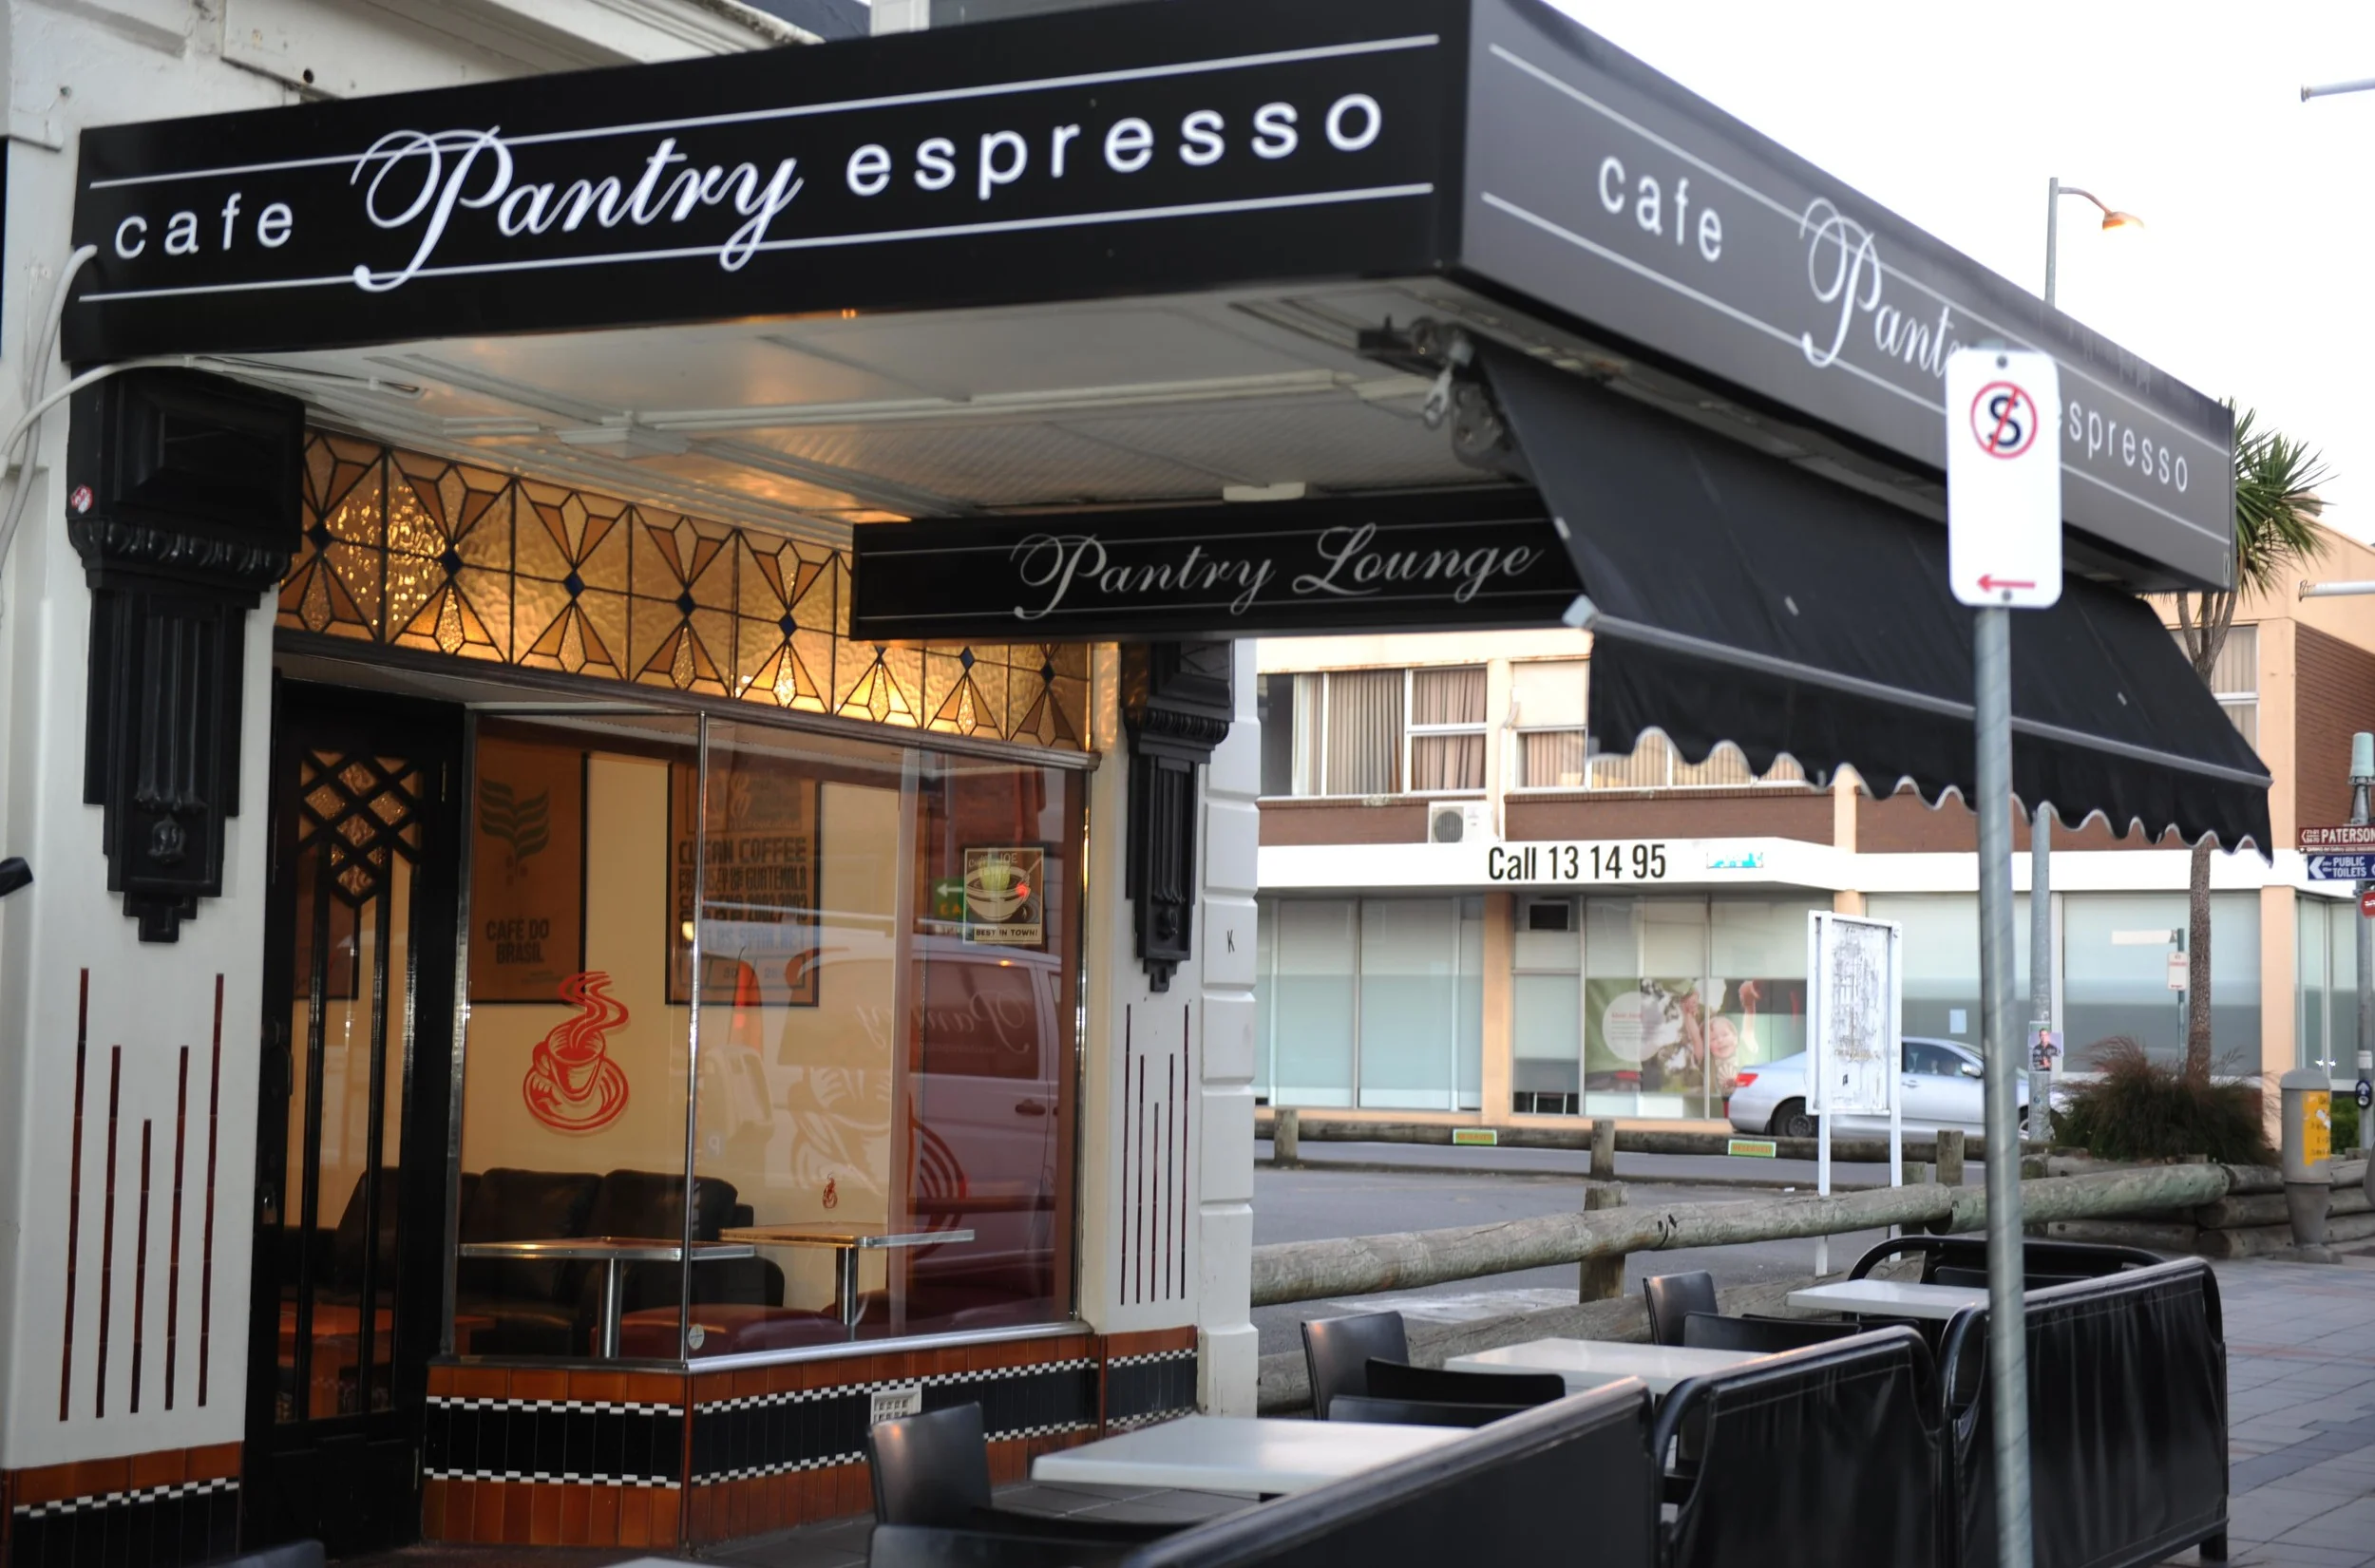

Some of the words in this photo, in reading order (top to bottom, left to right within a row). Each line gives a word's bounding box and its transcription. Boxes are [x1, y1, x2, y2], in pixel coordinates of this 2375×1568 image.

[115, 192, 294, 259] cafe
[350, 124, 804, 293] Pantry
[846, 93, 1382, 200] espresso
[1599, 156, 1722, 261] cafe
[1798, 197, 1967, 379] Pant
[2059, 400, 2188, 492] spresso
[1010, 533, 1277, 620] Pantry
[1292, 522, 1545, 603] Lounge
[738, 837, 807, 864] COFFEE
[1489, 846, 1536, 880] Call
[1548, 845, 1579, 879] 13
[1590, 845, 1623, 879] 14
[1632, 843, 1666, 879] 95
[2333, 856, 2365, 867] PUBLIC
[2333, 867, 2366, 878] TOILETS
[528, 917, 549, 939] DO
[976, 928, 996, 936] BEST
[998, 928, 1007, 936] IN
[1010, 928, 1038, 936] TOWN!
[496, 941, 544, 965] BRASIL
